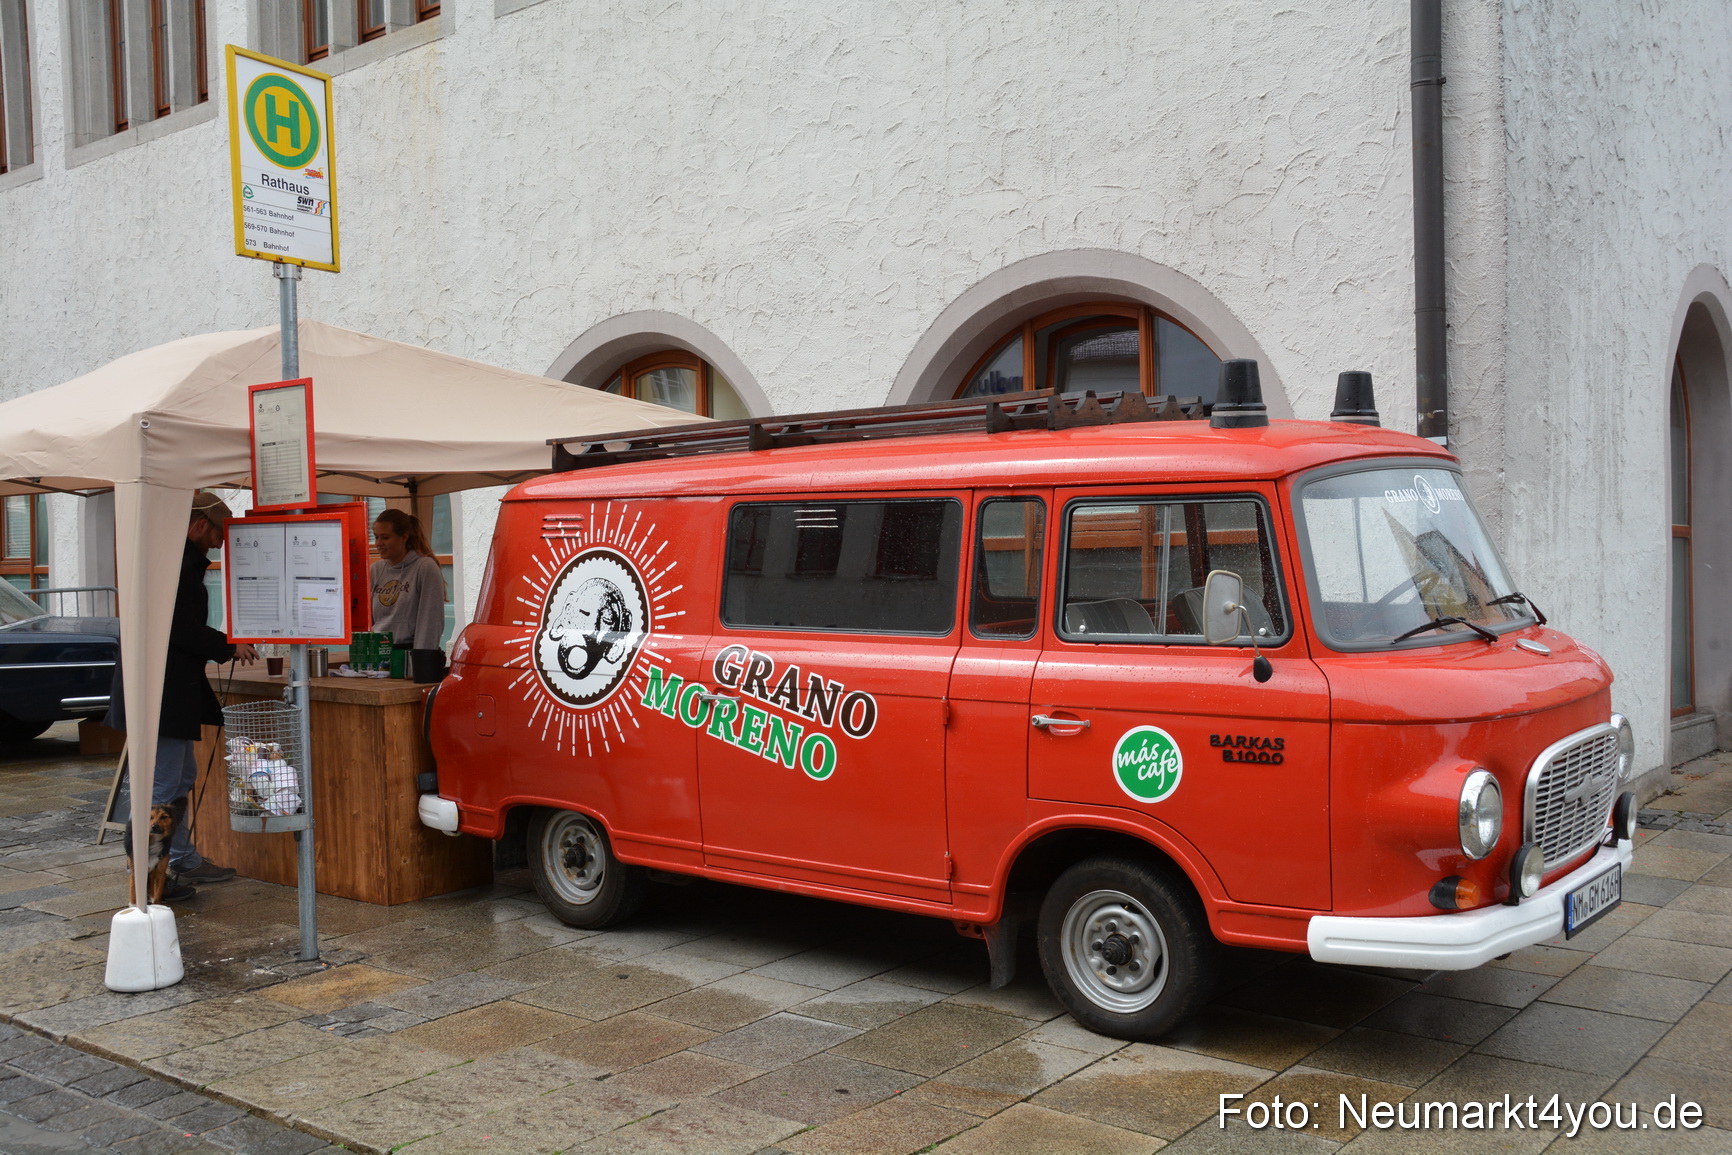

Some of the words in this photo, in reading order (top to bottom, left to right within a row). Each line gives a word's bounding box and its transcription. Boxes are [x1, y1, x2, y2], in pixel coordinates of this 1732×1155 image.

[261, 173, 310, 195] Rathaus
[243, 205, 267, 216] 561-563
[269, 210, 294, 221] Bahnhof
[244, 222, 268, 233] 569-570
[269, 227, 295, 237] Bahnhof
[245, 238, 257, 247] 573
[263, 242, 290, 252] Bahnhof
[1384, 488, 1419, 503] GRANO
[712, 644, 878, 740] GRANO
[641, 664, 837, 781] MORENO
[1209, 734, 1285, 750] BARKAS
[1118, 738, 1160, 768] más
[1222, 749, 1284, 765] B1000
[1137, 749, 1178, 790] café
